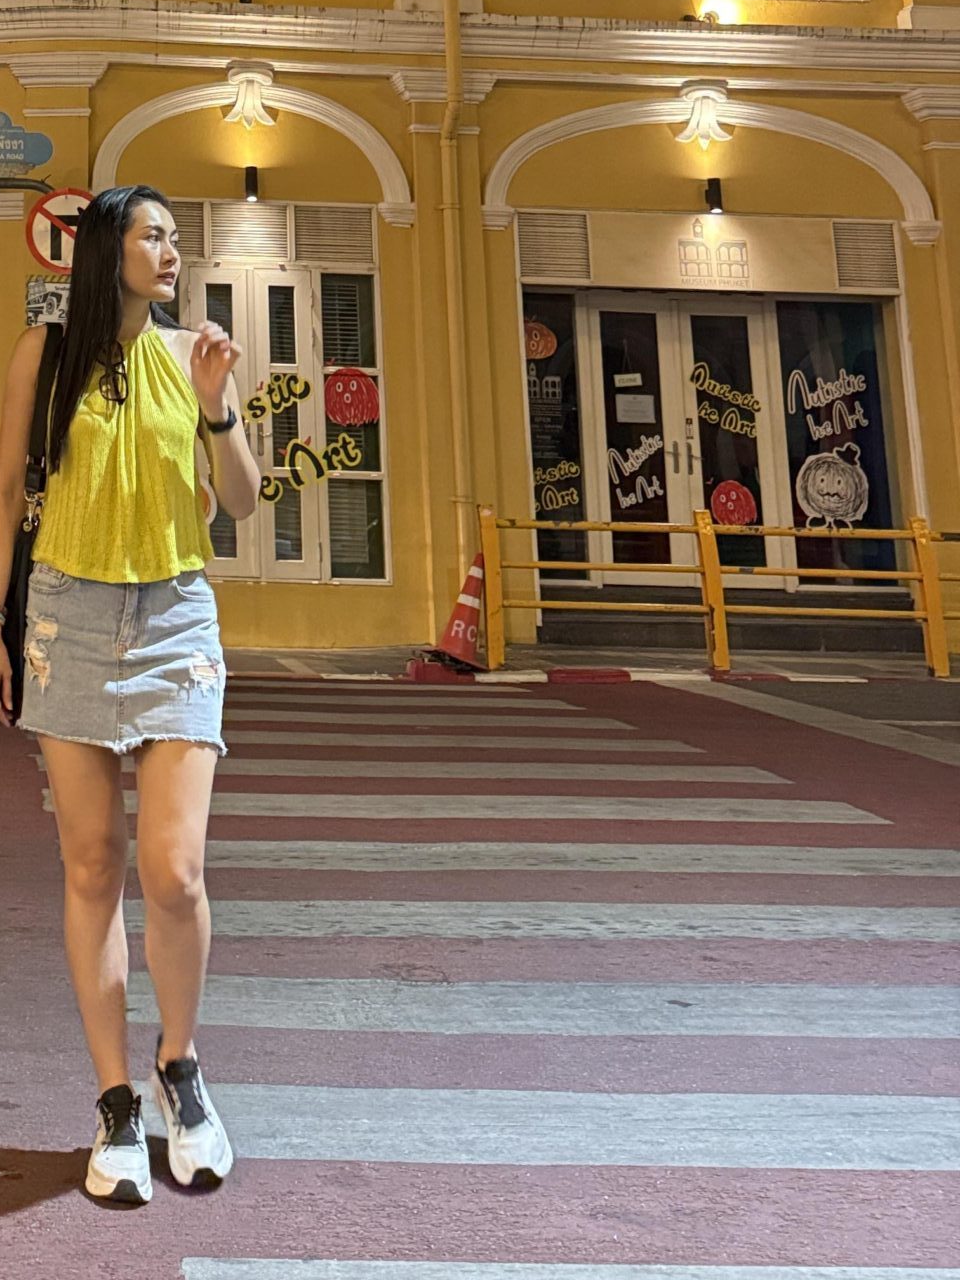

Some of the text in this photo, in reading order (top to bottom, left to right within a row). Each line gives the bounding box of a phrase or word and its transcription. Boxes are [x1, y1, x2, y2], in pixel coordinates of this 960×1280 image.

[681, 278, 749, 287] MUSEUM PHUKET
[241, 372, 311, 420] stic
[690, 362, 761, 413] Autistic
[788, 368, 866, 414] Autistic
[833, 400, 869, 435] Art
[286, 434, 361, 488] Art
[534, 460, 581, 484] tistic
[541, 485, 579, 510] Art
